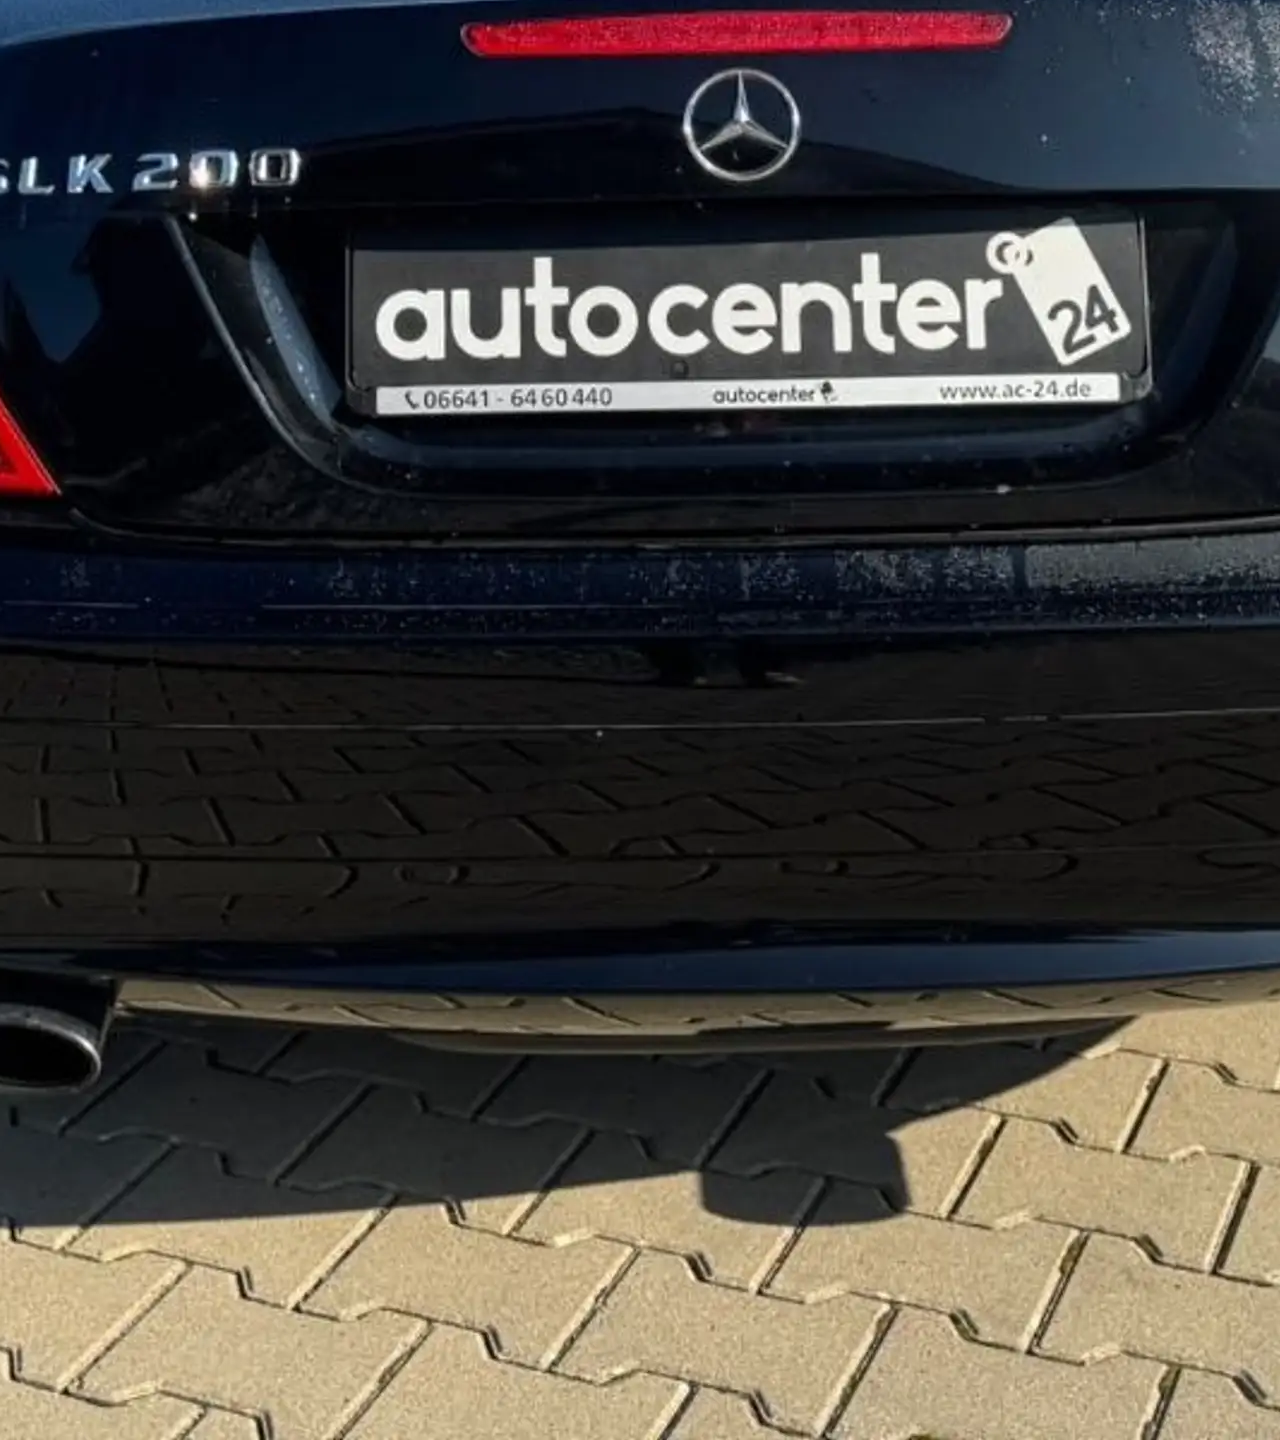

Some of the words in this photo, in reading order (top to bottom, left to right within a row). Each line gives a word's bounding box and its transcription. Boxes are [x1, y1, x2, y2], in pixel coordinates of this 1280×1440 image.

[131, 147, 303, 191] 200
[1046, 284, 1120, 355] 24
[422, 389, 490, 410] 06641
[712, 384, 816, 405] autocenter
[939, 378, 1093, 401] www.ac-24.de
